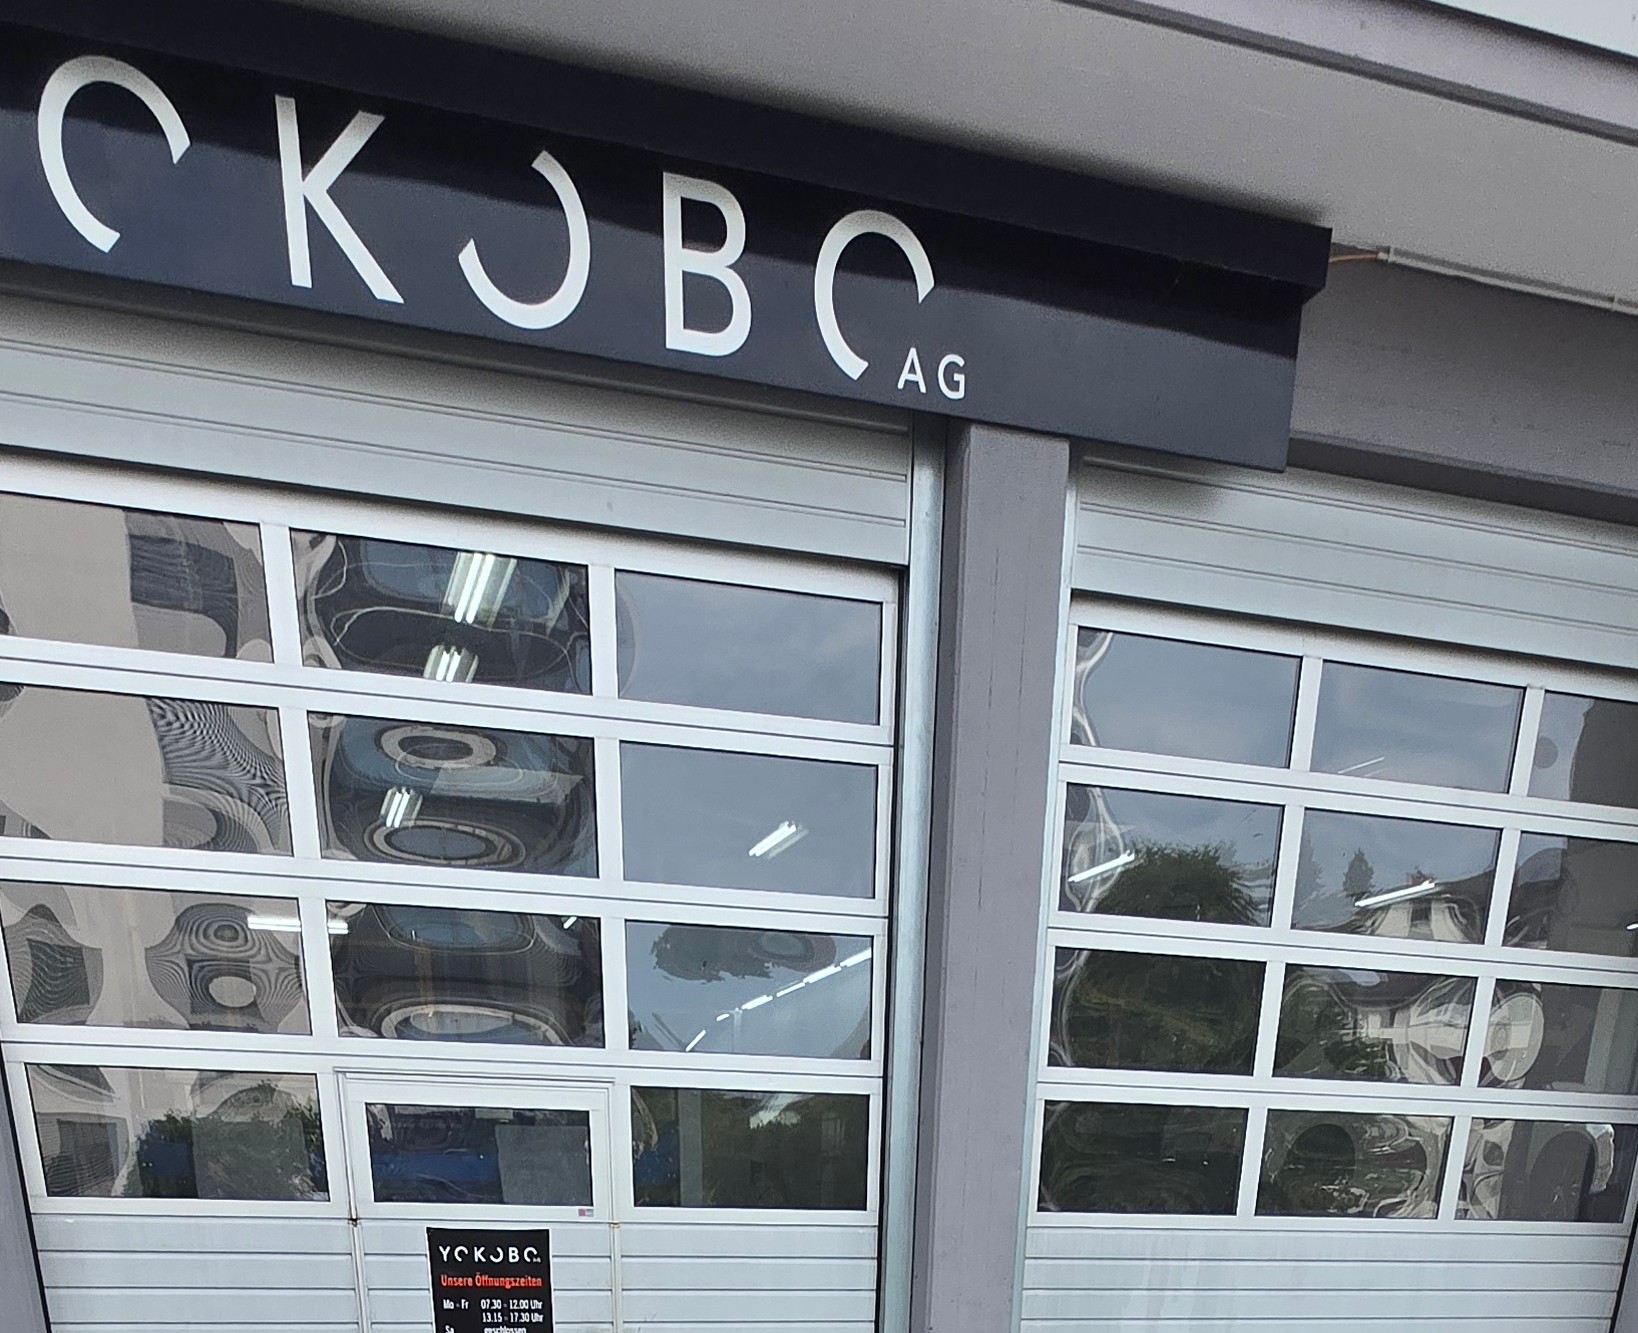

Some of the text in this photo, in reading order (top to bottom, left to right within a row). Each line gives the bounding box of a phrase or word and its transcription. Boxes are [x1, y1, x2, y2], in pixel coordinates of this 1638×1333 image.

[897, 347, 966, 400] AG
[438, 1245, 537, 1263] YOKOBO
[440, 1271, 542, 1289] Unsere Öffnungszeiten
[461, 1299, 469, 1309] Fr
[480, 1299, 502, 1310] 07.30
[509, 1299, 529, 1310] 12.00
[530, 1299, 543, 1310] Uhr
[482, 1312, 502, 1323] 13.15
[510, 1312, 530, 1323] 17.30
[531, 1312, 544, 1323] Uhr
